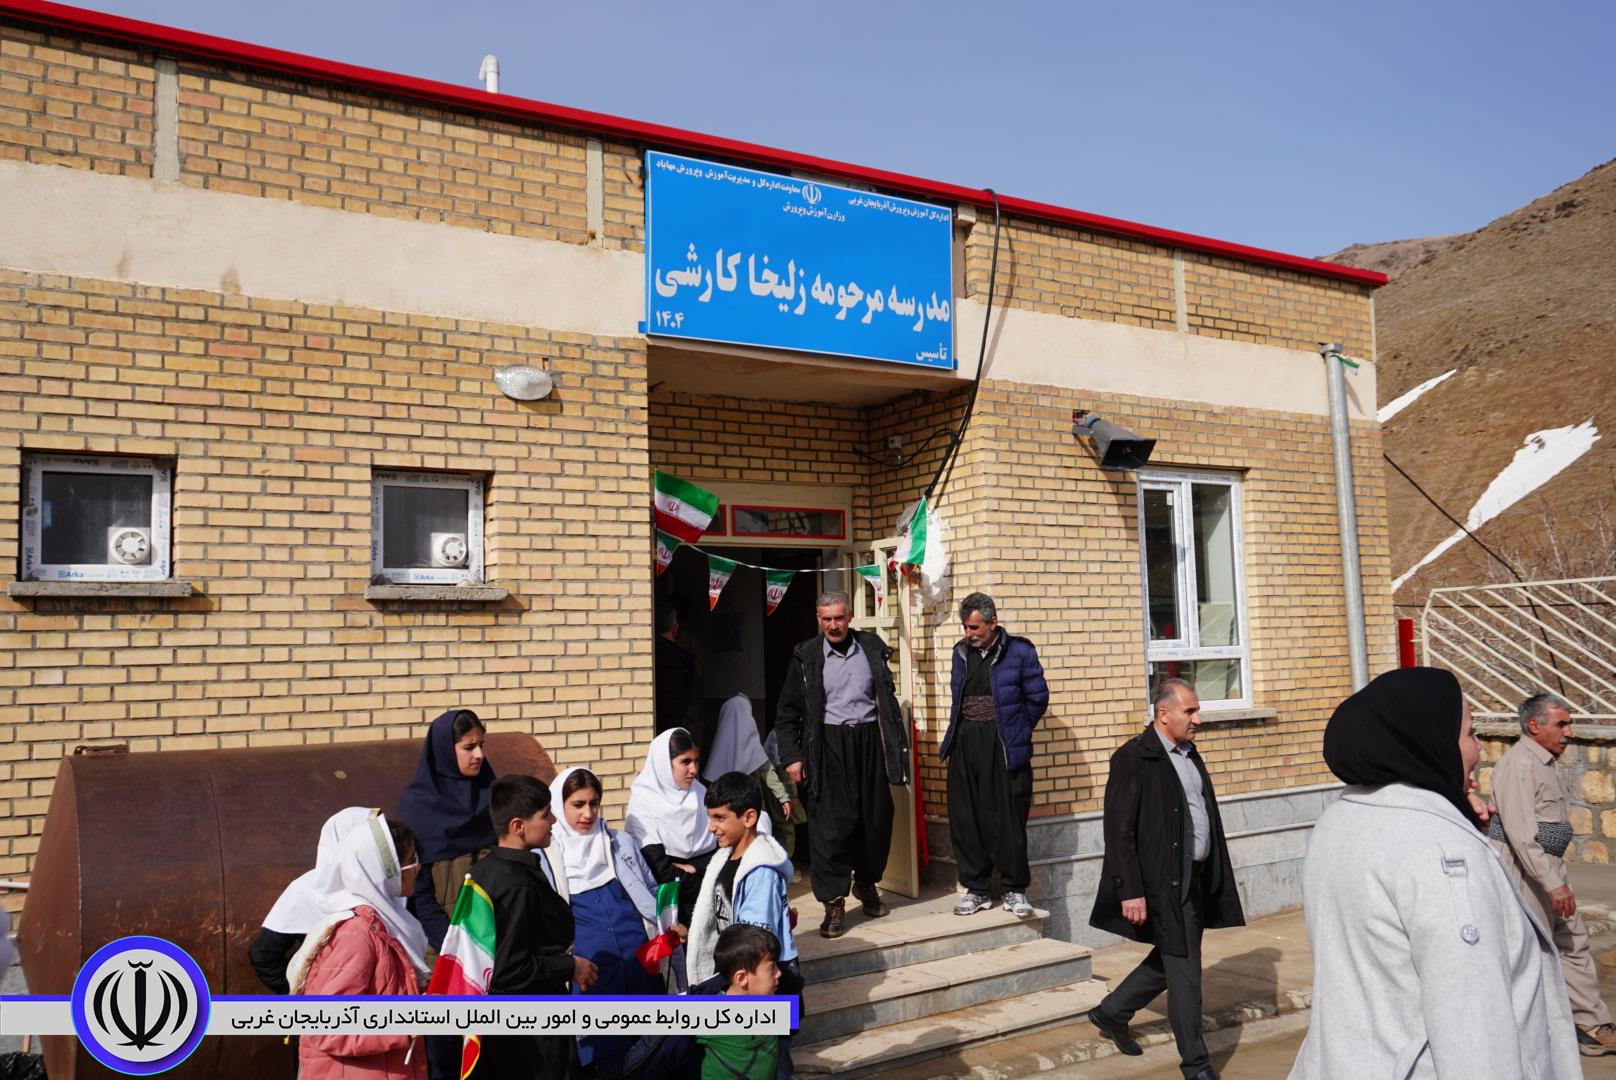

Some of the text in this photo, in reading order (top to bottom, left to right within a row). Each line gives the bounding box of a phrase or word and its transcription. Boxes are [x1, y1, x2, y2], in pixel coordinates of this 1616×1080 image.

[656, 159, 676, 171] مهاباد
[705, 169, 728, 180] آموزش
[728, 174, 751, 184] مدیریت
[752, 179, 757, 187] و
[848, 195, 863, 206] غربی
[863, 198, 889, 211] آذربایجان
[807, 206, 828, 218] آموزش
[911, 208, 929, 218] آموزش
[655, 242, 950, 332] مدرسه مرحومه زلیخا کارشی
